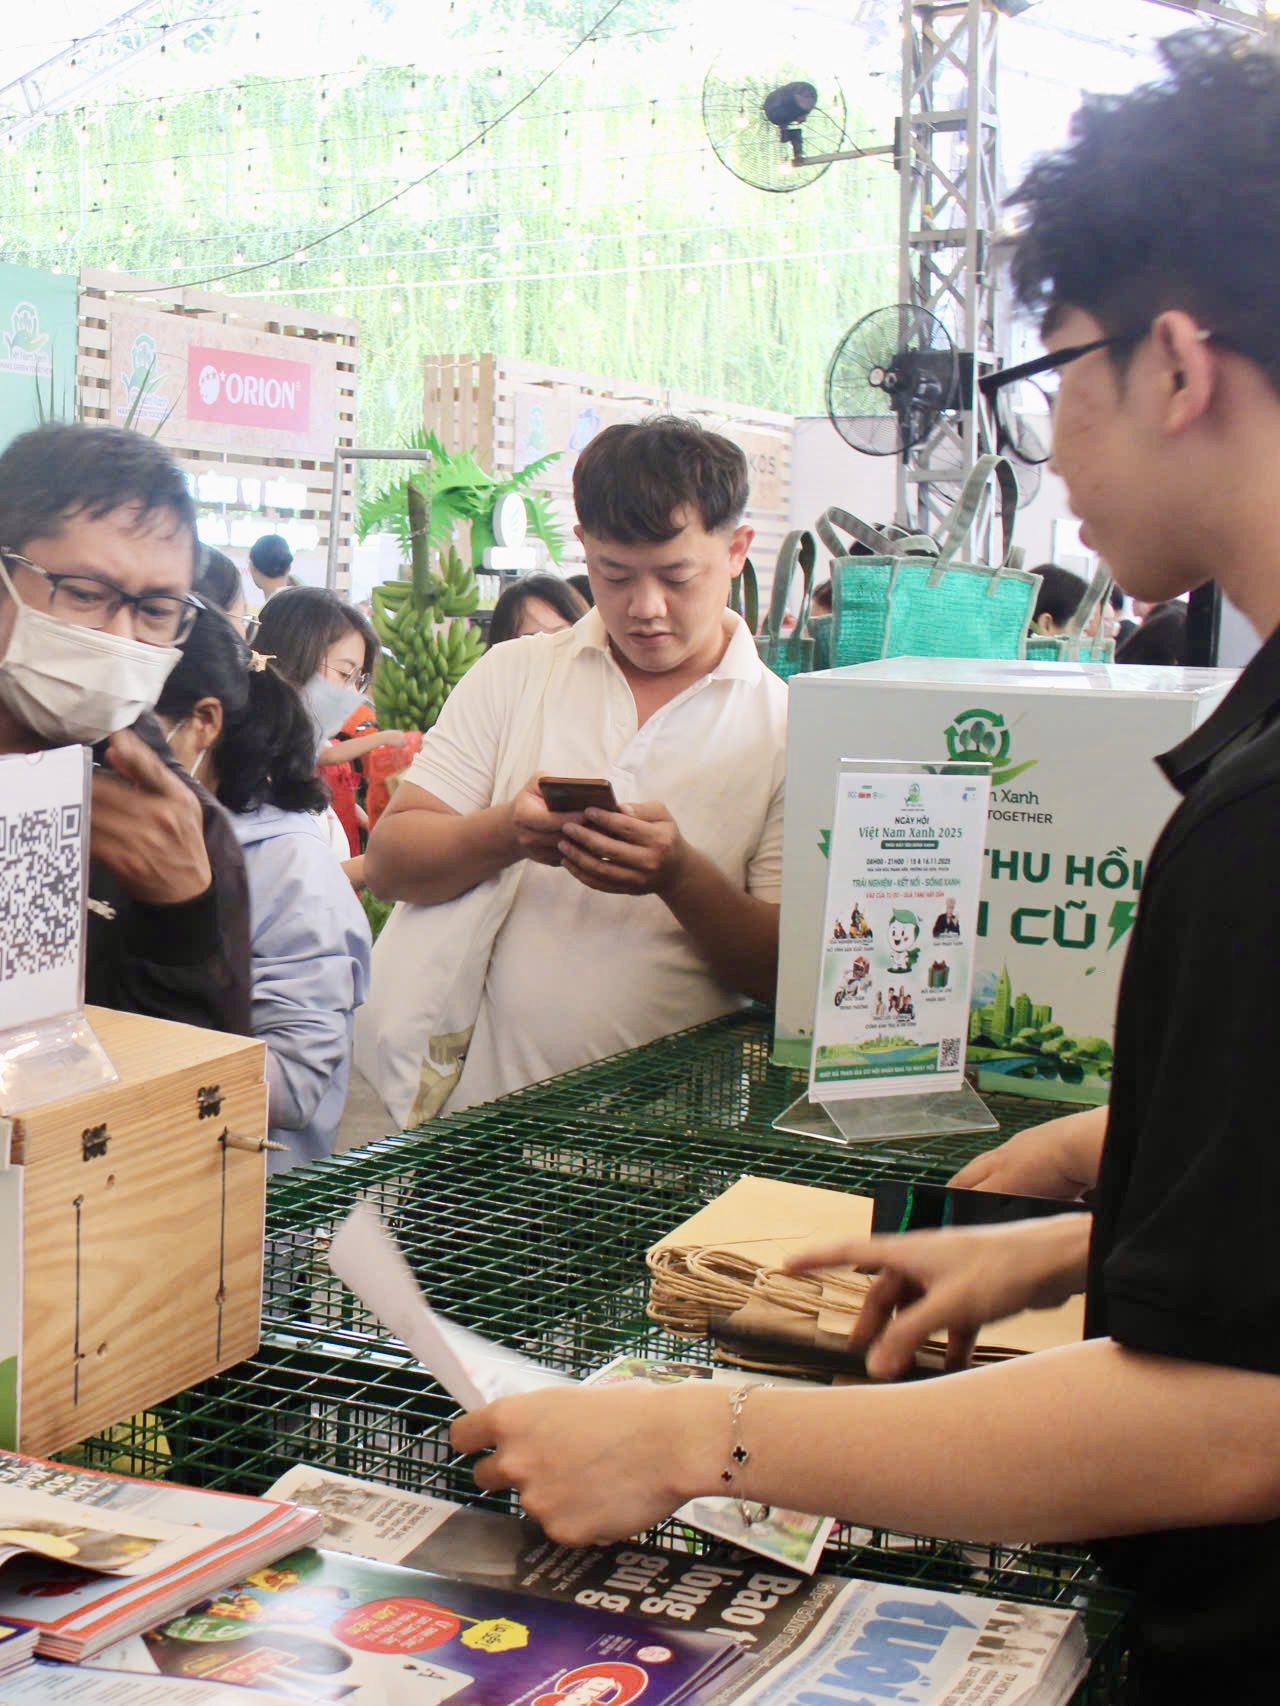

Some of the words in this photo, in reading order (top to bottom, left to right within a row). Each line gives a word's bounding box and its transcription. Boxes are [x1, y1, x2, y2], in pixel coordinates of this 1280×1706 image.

[225, 372, 296, 410] ORION
[1001, 789, 1040, 805] Xanh
[894, 815, 915, 825] NGÀY
[987, 809, 1053, 824] TOGETHER
[858, 826, 879, 840] Việt
[882, 827, 906, 839] Nam
[908, 827, 935, 839] Xanh
[938, 827, 963, 839] 2025
[984, 848, 1051, 883] HU
[1064, 846, 1143, 891] HỒI
[1010, 899, 1097, 949] CŨ
[721, 1572, 803, 1626] Bao
